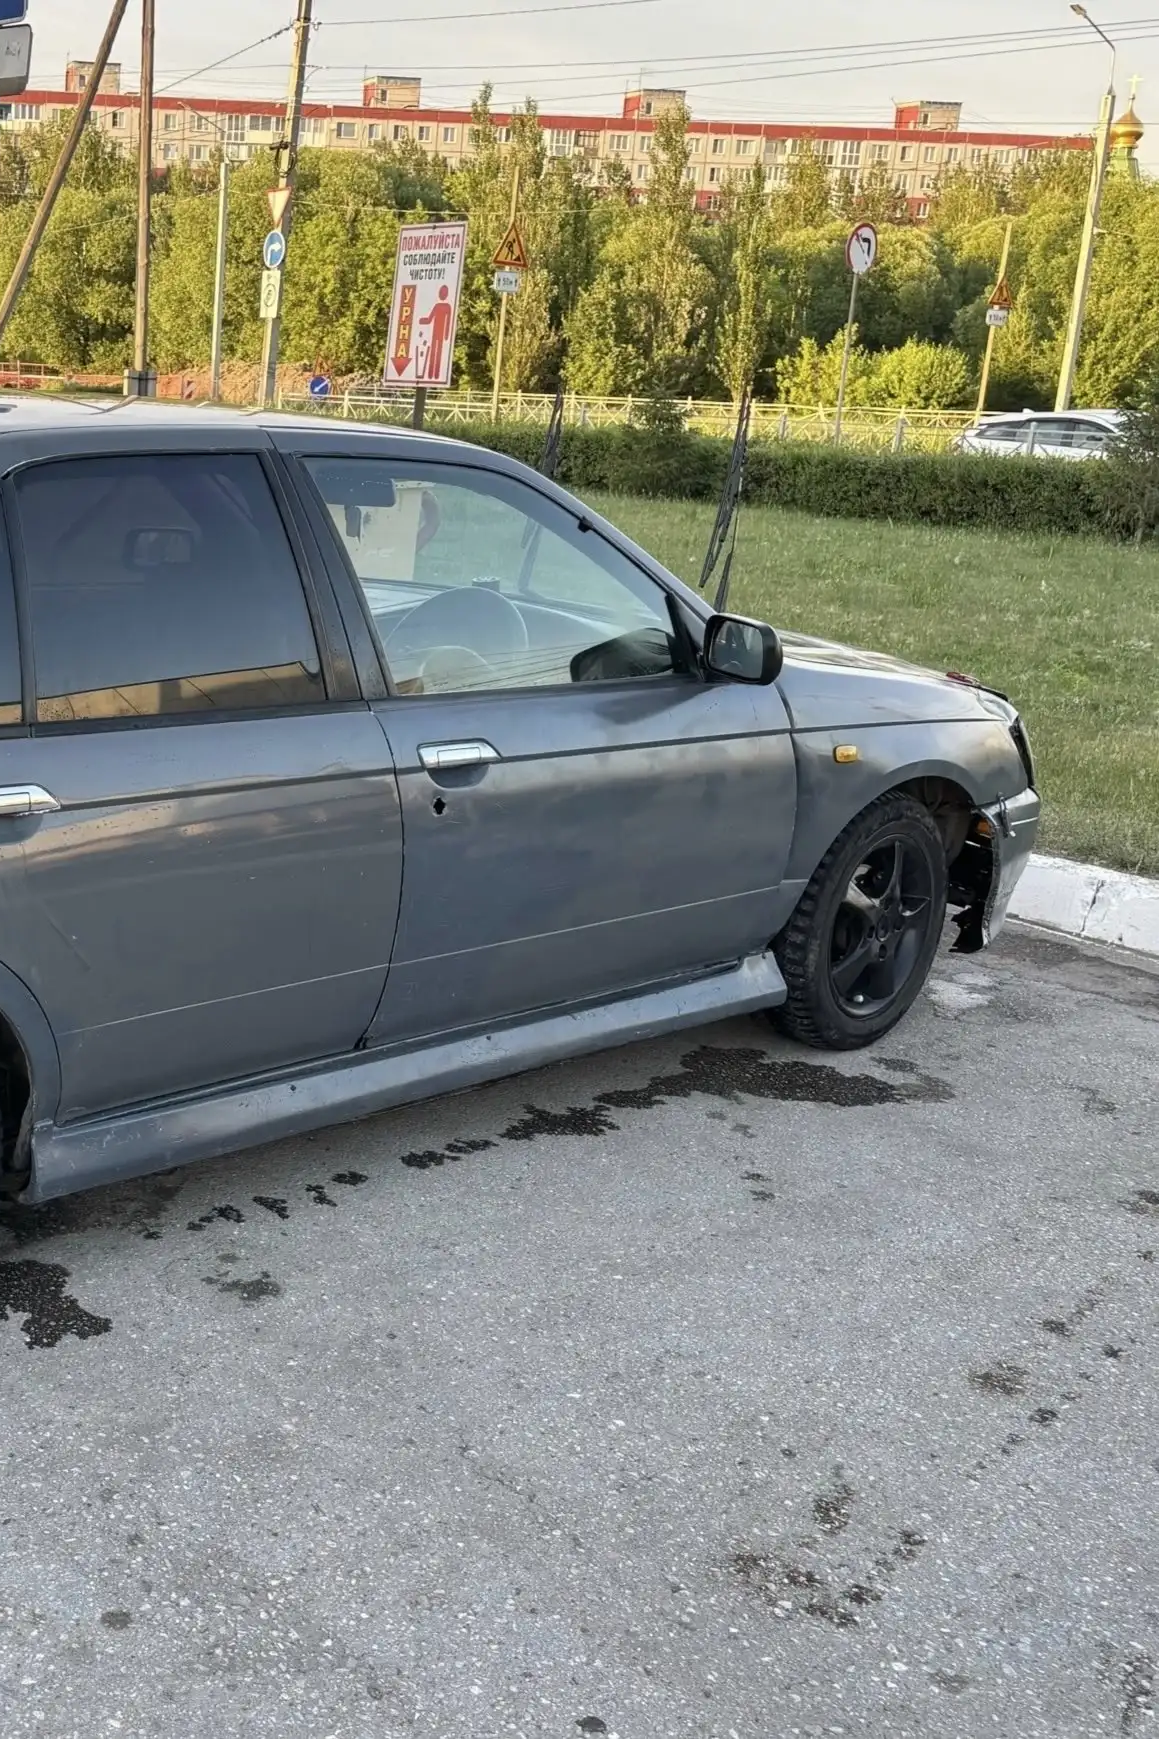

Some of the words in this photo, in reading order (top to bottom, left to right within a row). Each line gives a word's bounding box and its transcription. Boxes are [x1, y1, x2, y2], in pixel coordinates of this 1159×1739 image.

[401, 232, 461, 251] ПОЖАЛУЙСТА
[403, 251, 456, 267] СОБЛЮДАЙТЕ
[409, 268, 446, 281] ЧИСТОТУ!
[396, 287, 413, 358] УРНА
